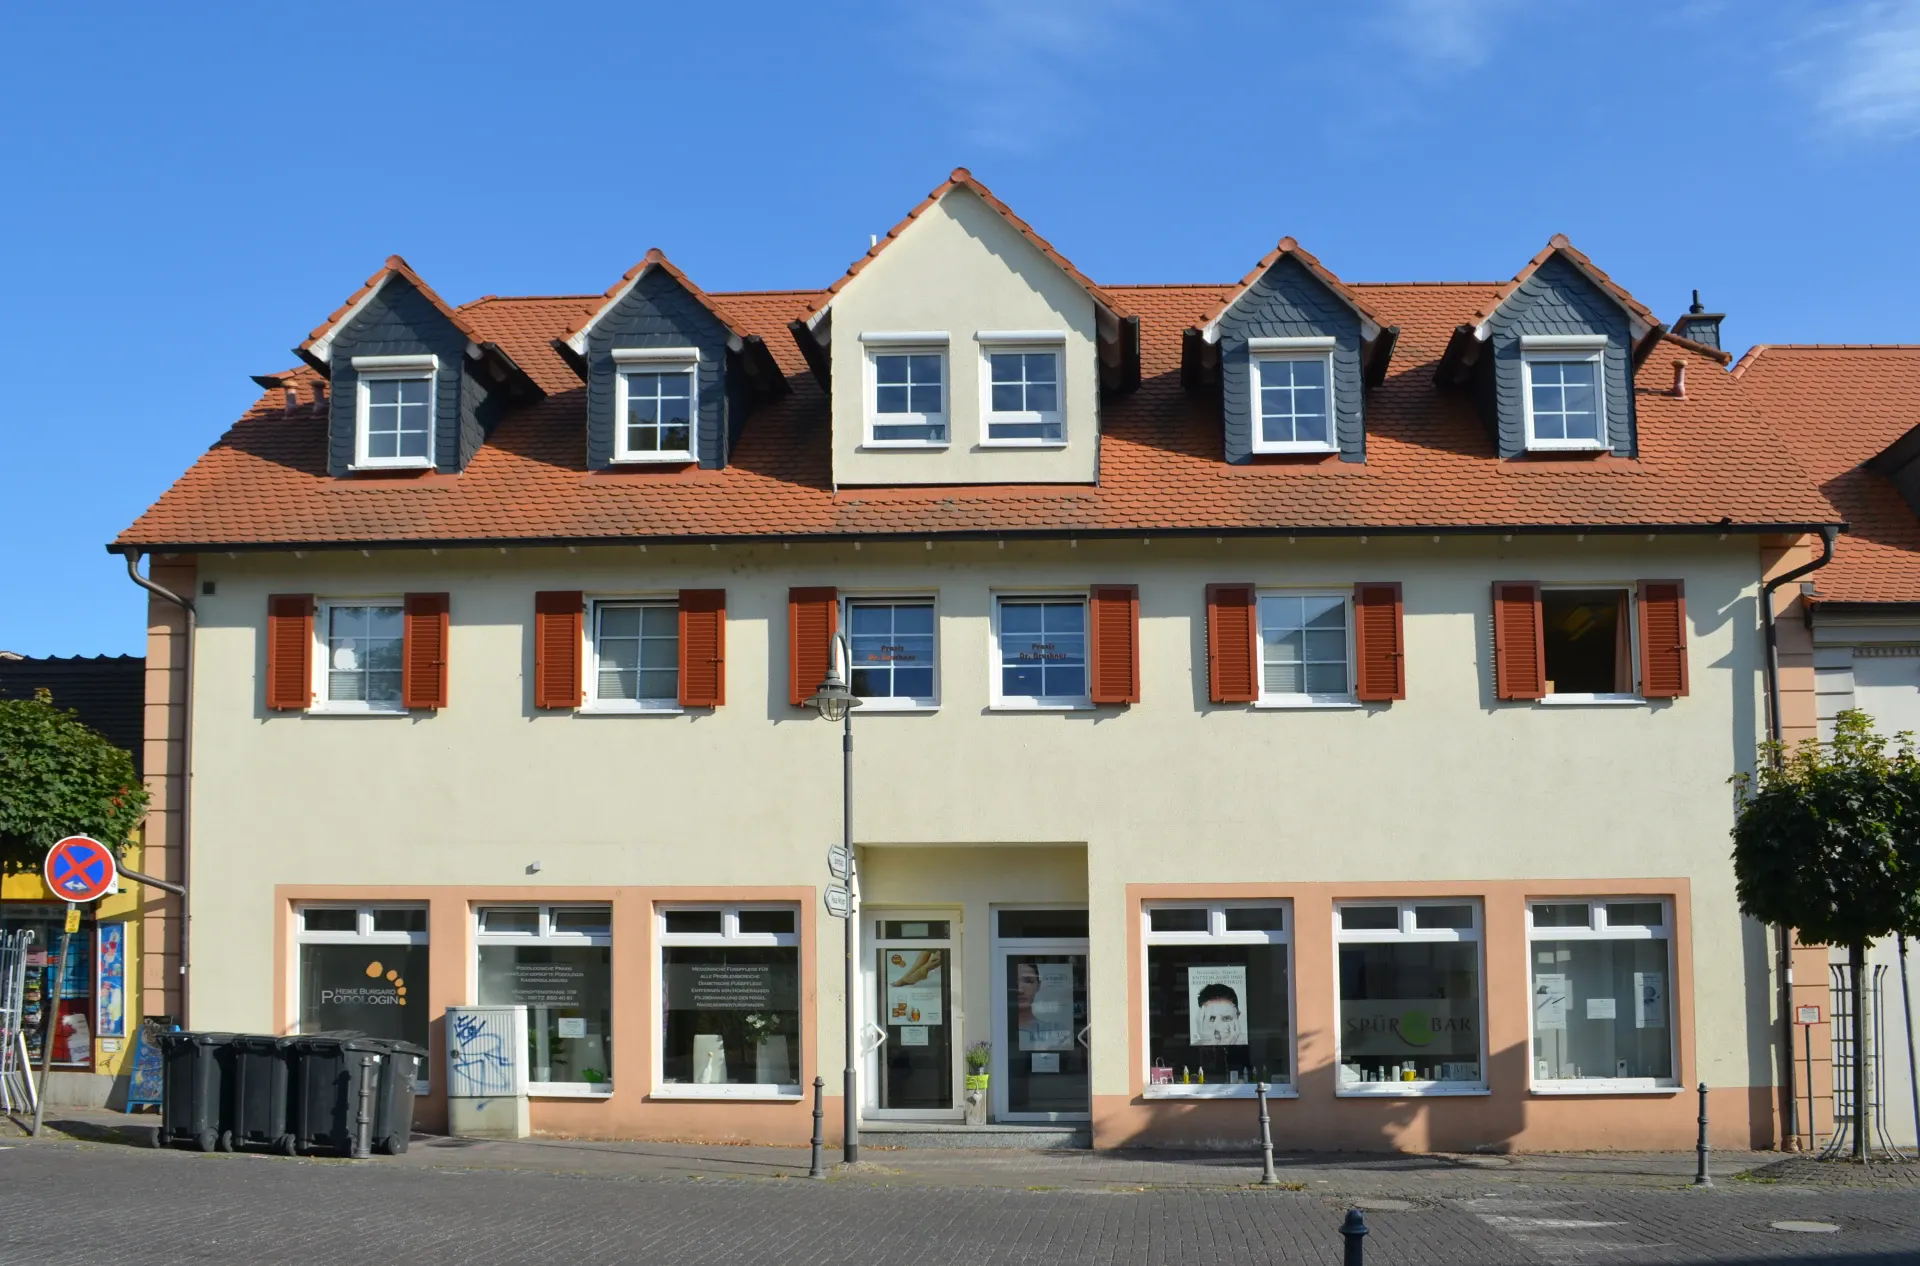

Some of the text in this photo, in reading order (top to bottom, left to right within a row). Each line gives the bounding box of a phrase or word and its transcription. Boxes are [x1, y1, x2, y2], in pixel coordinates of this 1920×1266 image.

[321, 990, 399, 1005] PODOLOGIN
[1346, 1014, 1472, 1032] SPÜR BAR
